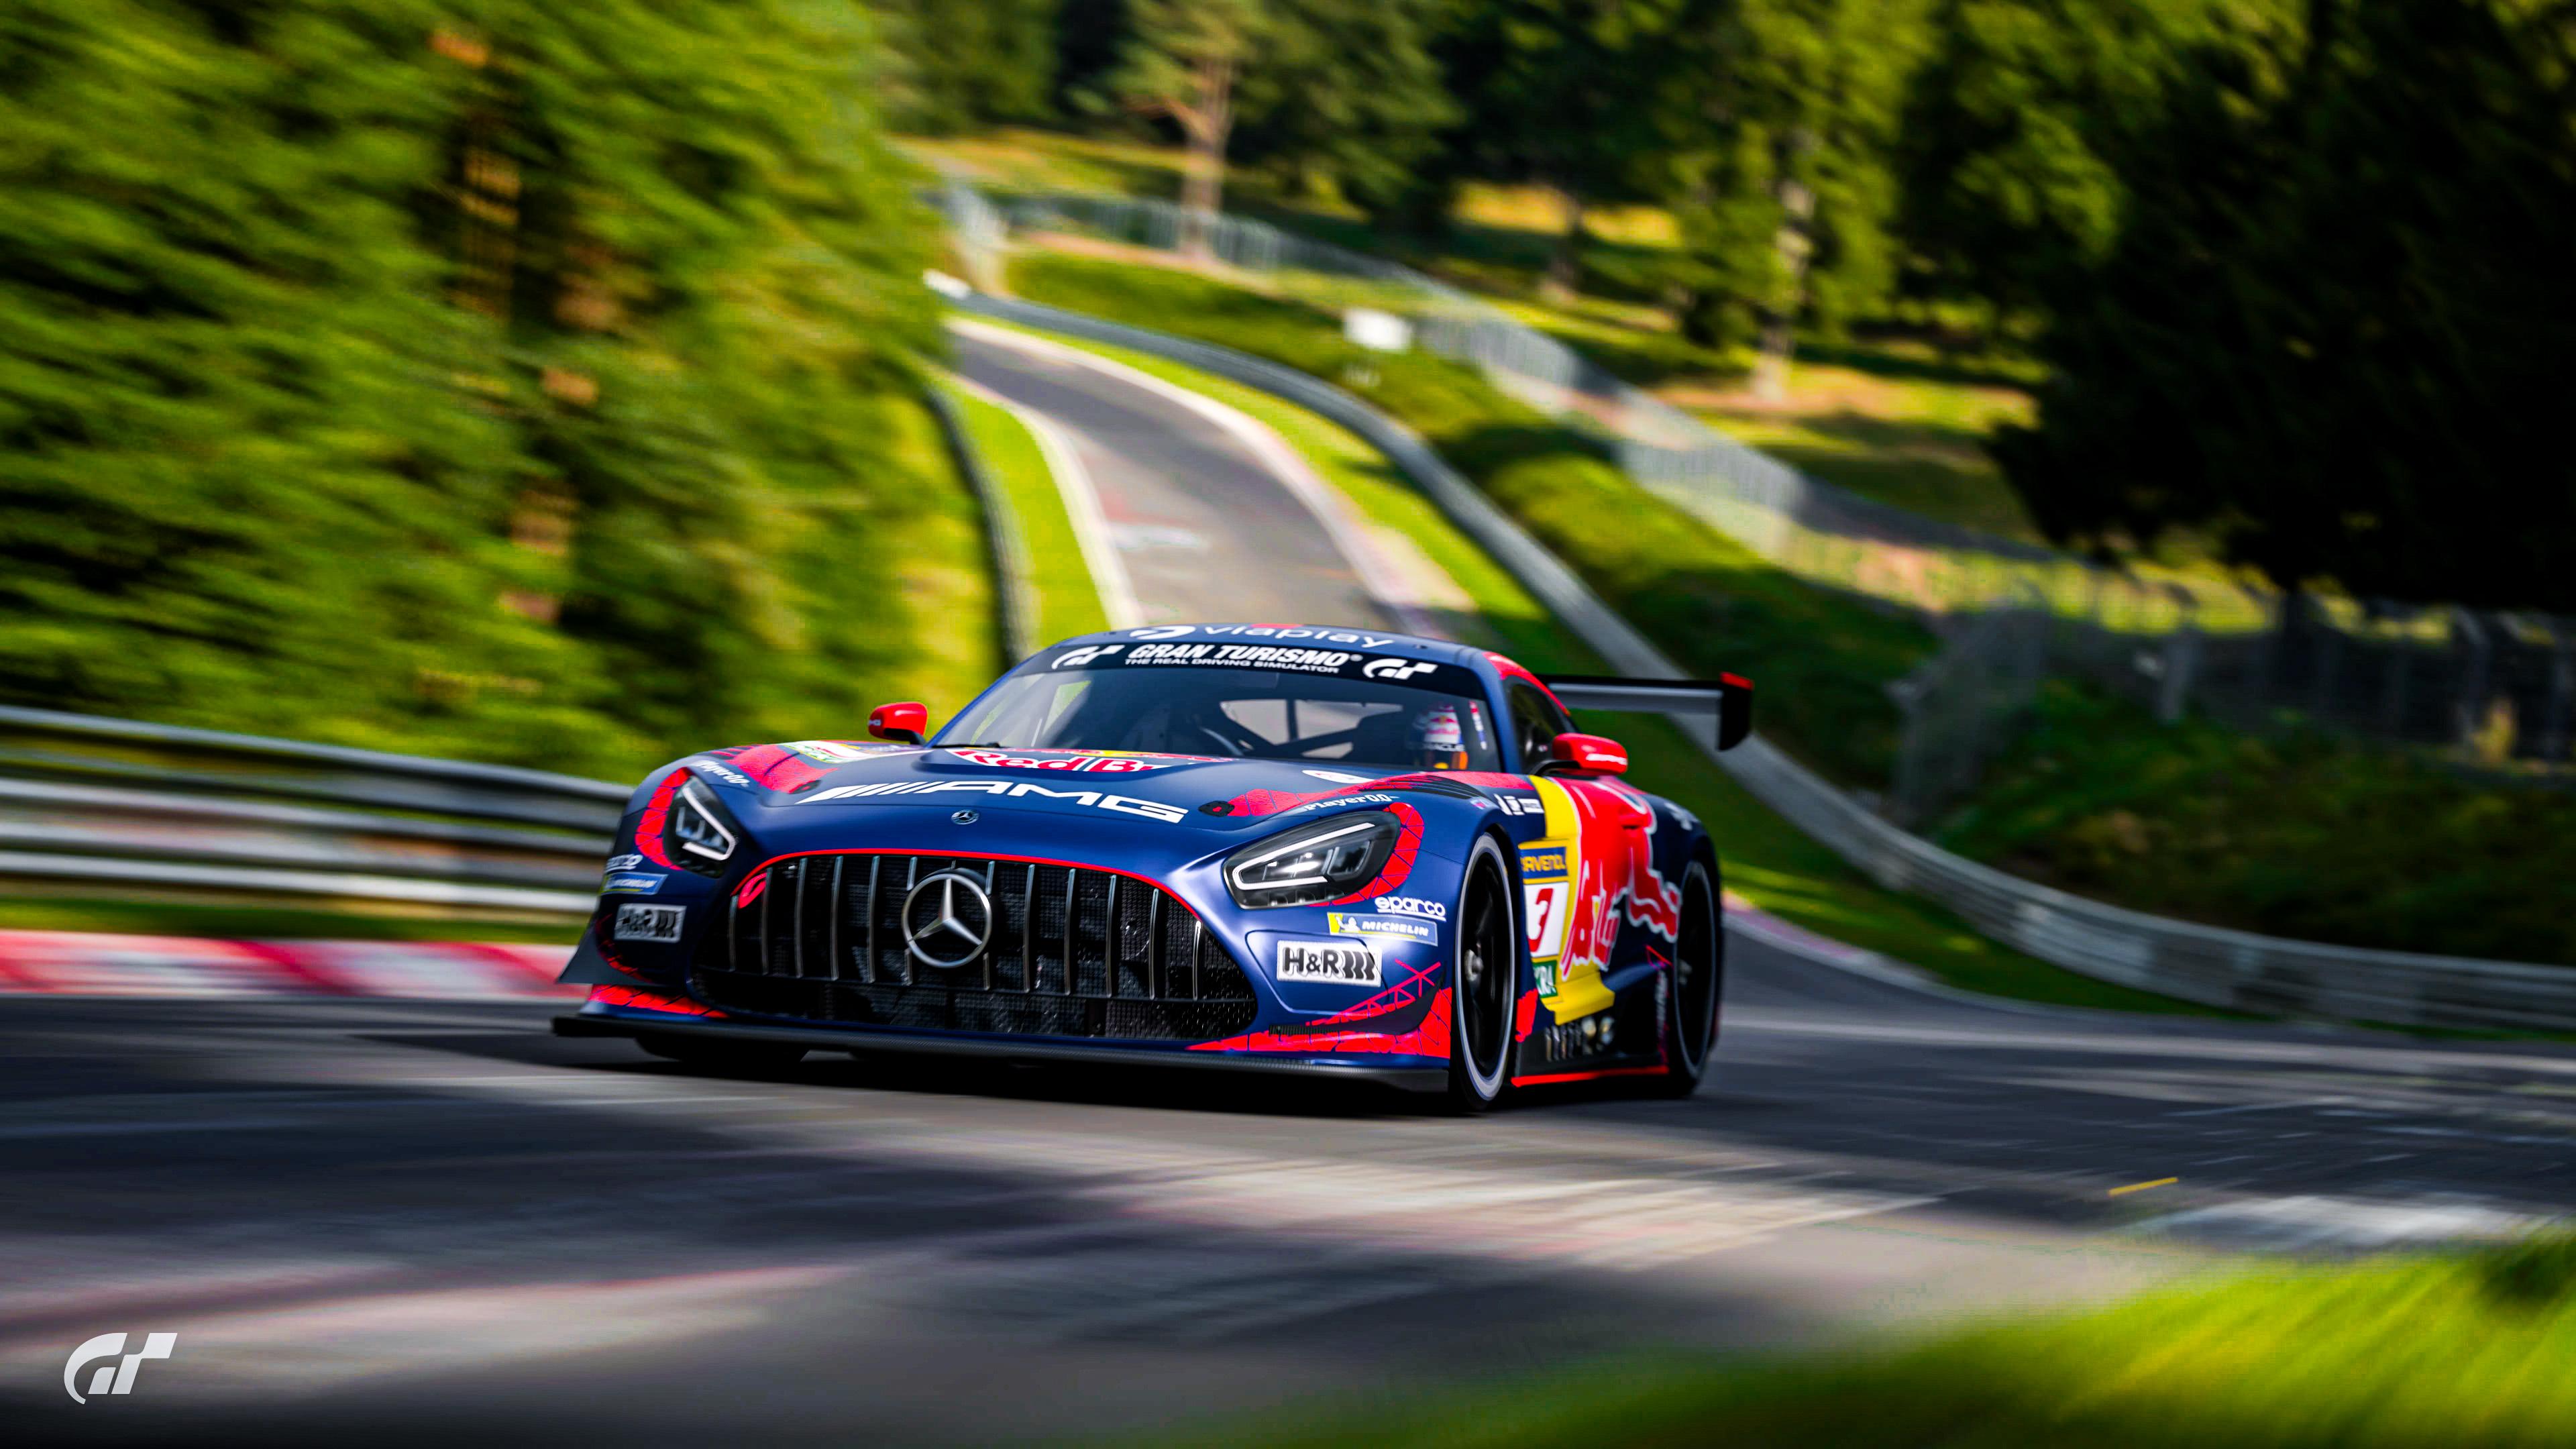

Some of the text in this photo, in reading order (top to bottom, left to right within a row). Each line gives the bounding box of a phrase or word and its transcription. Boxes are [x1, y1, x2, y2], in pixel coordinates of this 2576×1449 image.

[1205, 624, 1395, 648] viaplay
[1128, 643, 1216, 659] GRAN
[1191, 658, 1250, 667] DRIVING
[1253, 660, 1340, 674] SIMULATOR
[1375, 896, 1446, 916] sparco
[1362, 920, 1429, 936] MICHELIN
[1527, 888, 1554, 953] 3
[1283, 947, 1340, 975] H&R
